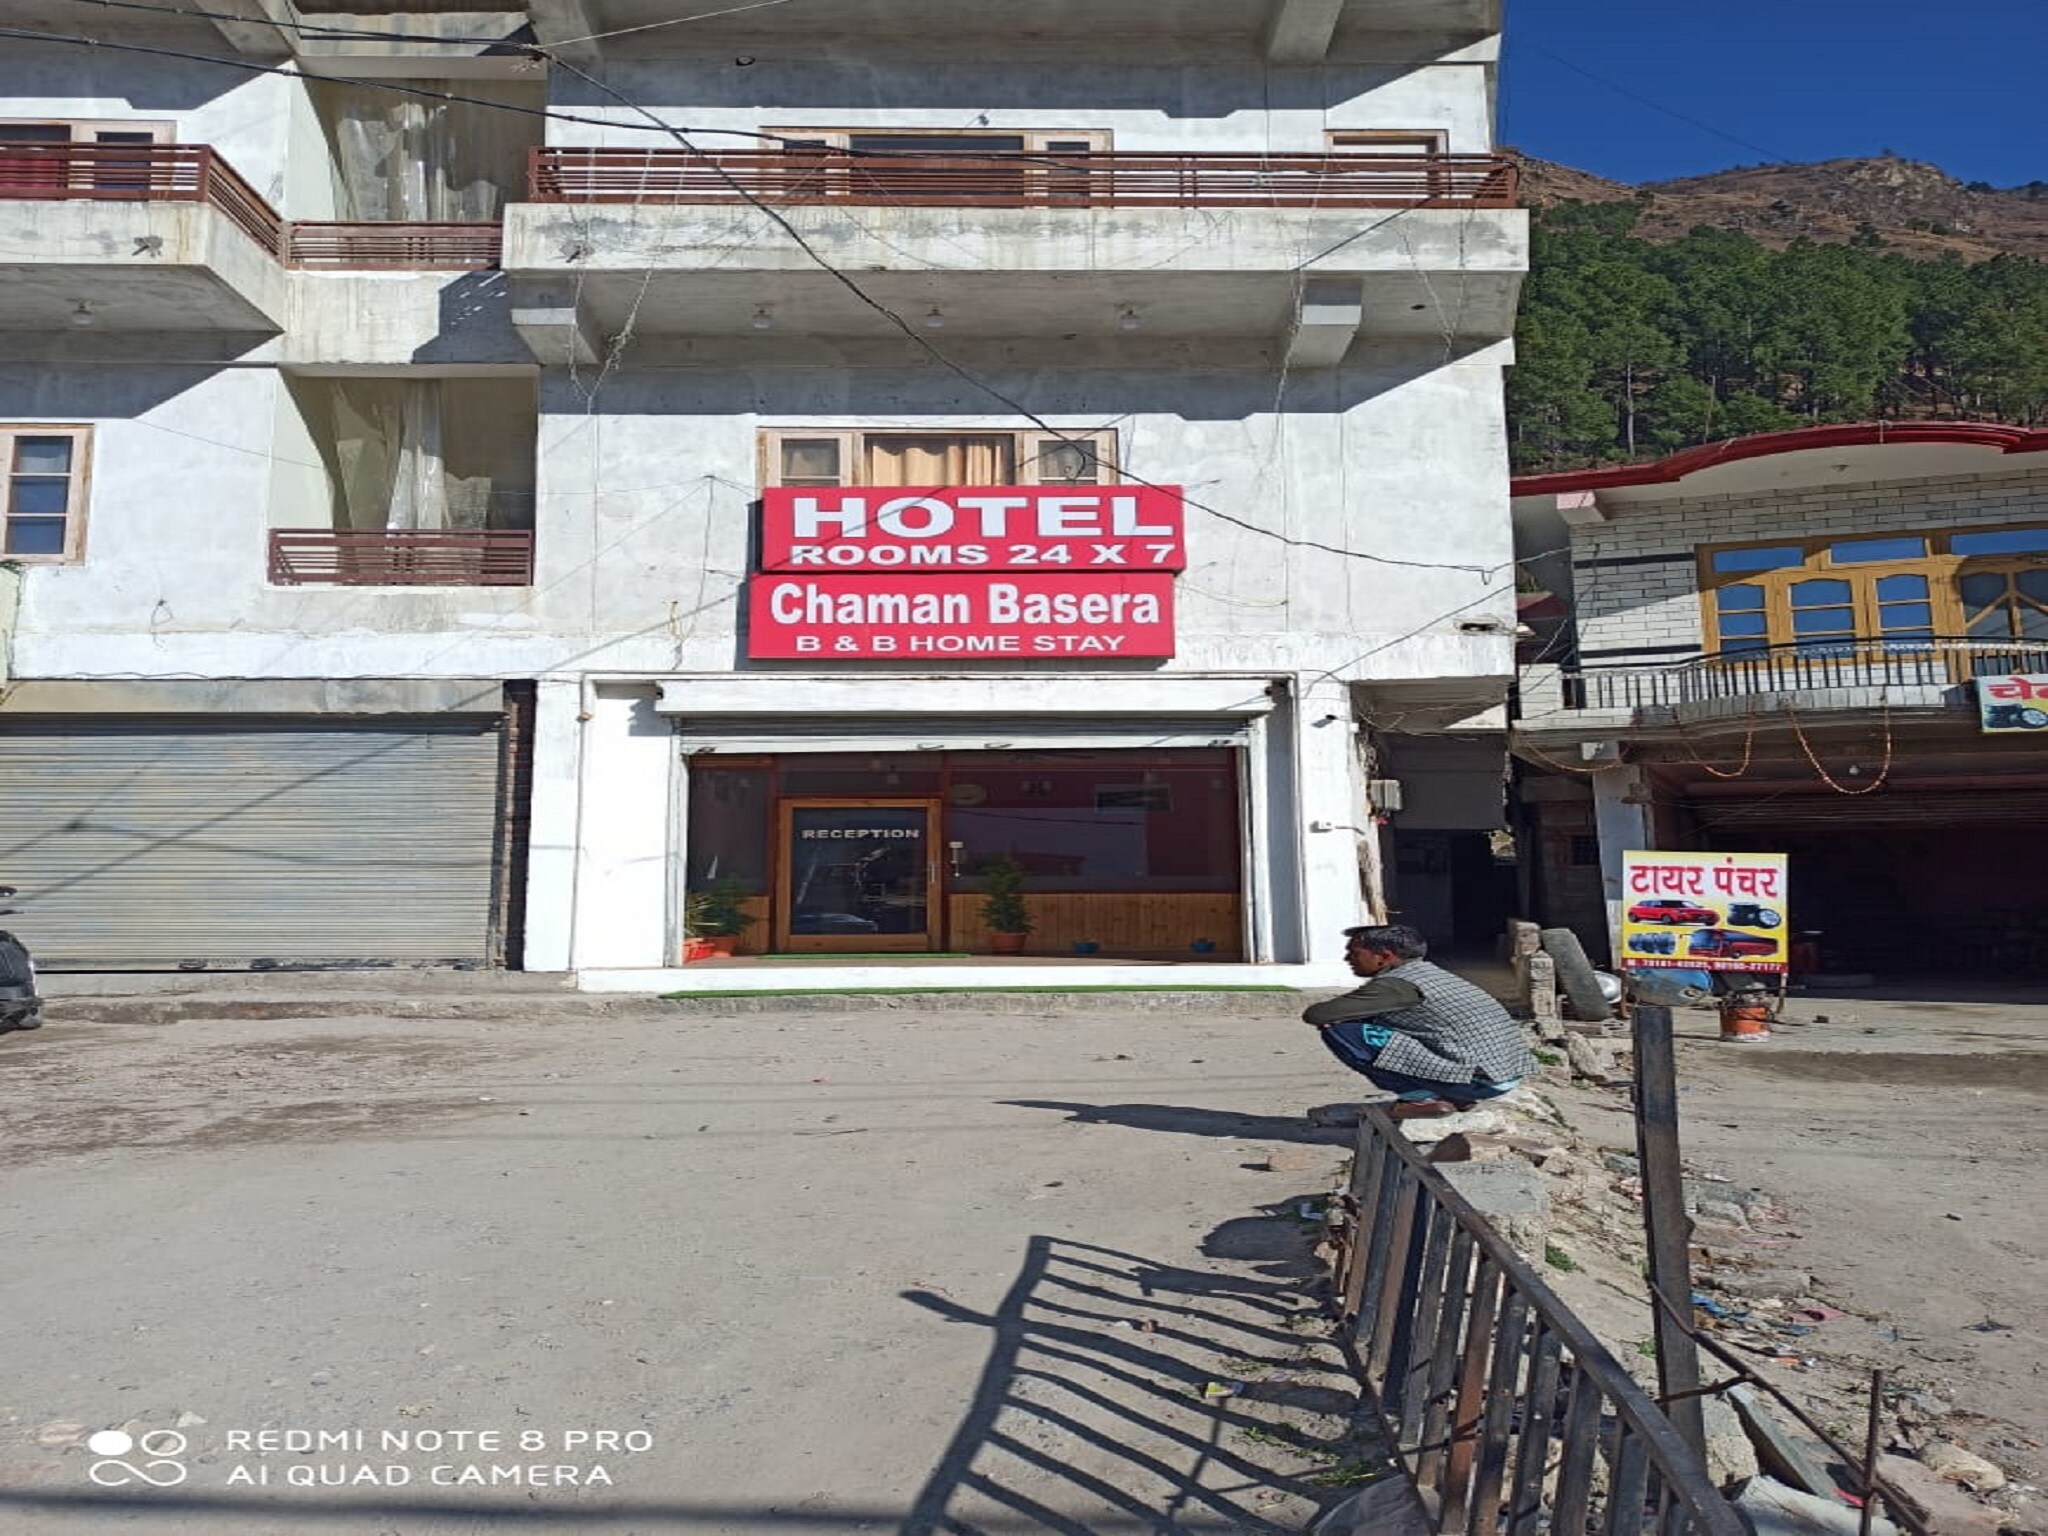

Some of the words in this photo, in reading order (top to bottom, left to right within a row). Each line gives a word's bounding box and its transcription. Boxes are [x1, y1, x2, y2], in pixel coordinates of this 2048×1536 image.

[792, 496, 1173, 538] HOTEL
[790, 543, 990, 565] ROOMS
[1008, 543, 1072, 565] 24
[1091, 543, 1127, 565] X
[1146, 543, 1176, 565] 7
[770, 582, 971, 625] Chaman
[988, 583, 1160, 625] Basera
[795, 635, 822, 652] B
[834, 635, 859, 652] &
[872, 635, 898, 652] B
[910, 635, 1021, 652] HOME
[1033, 635, 1127, 652] STAY
[801, 828, 920, 840] RECEPTION
[1629, 865, 1705, 895] टायर
[1712, 856, 1779, 898] पंचर
